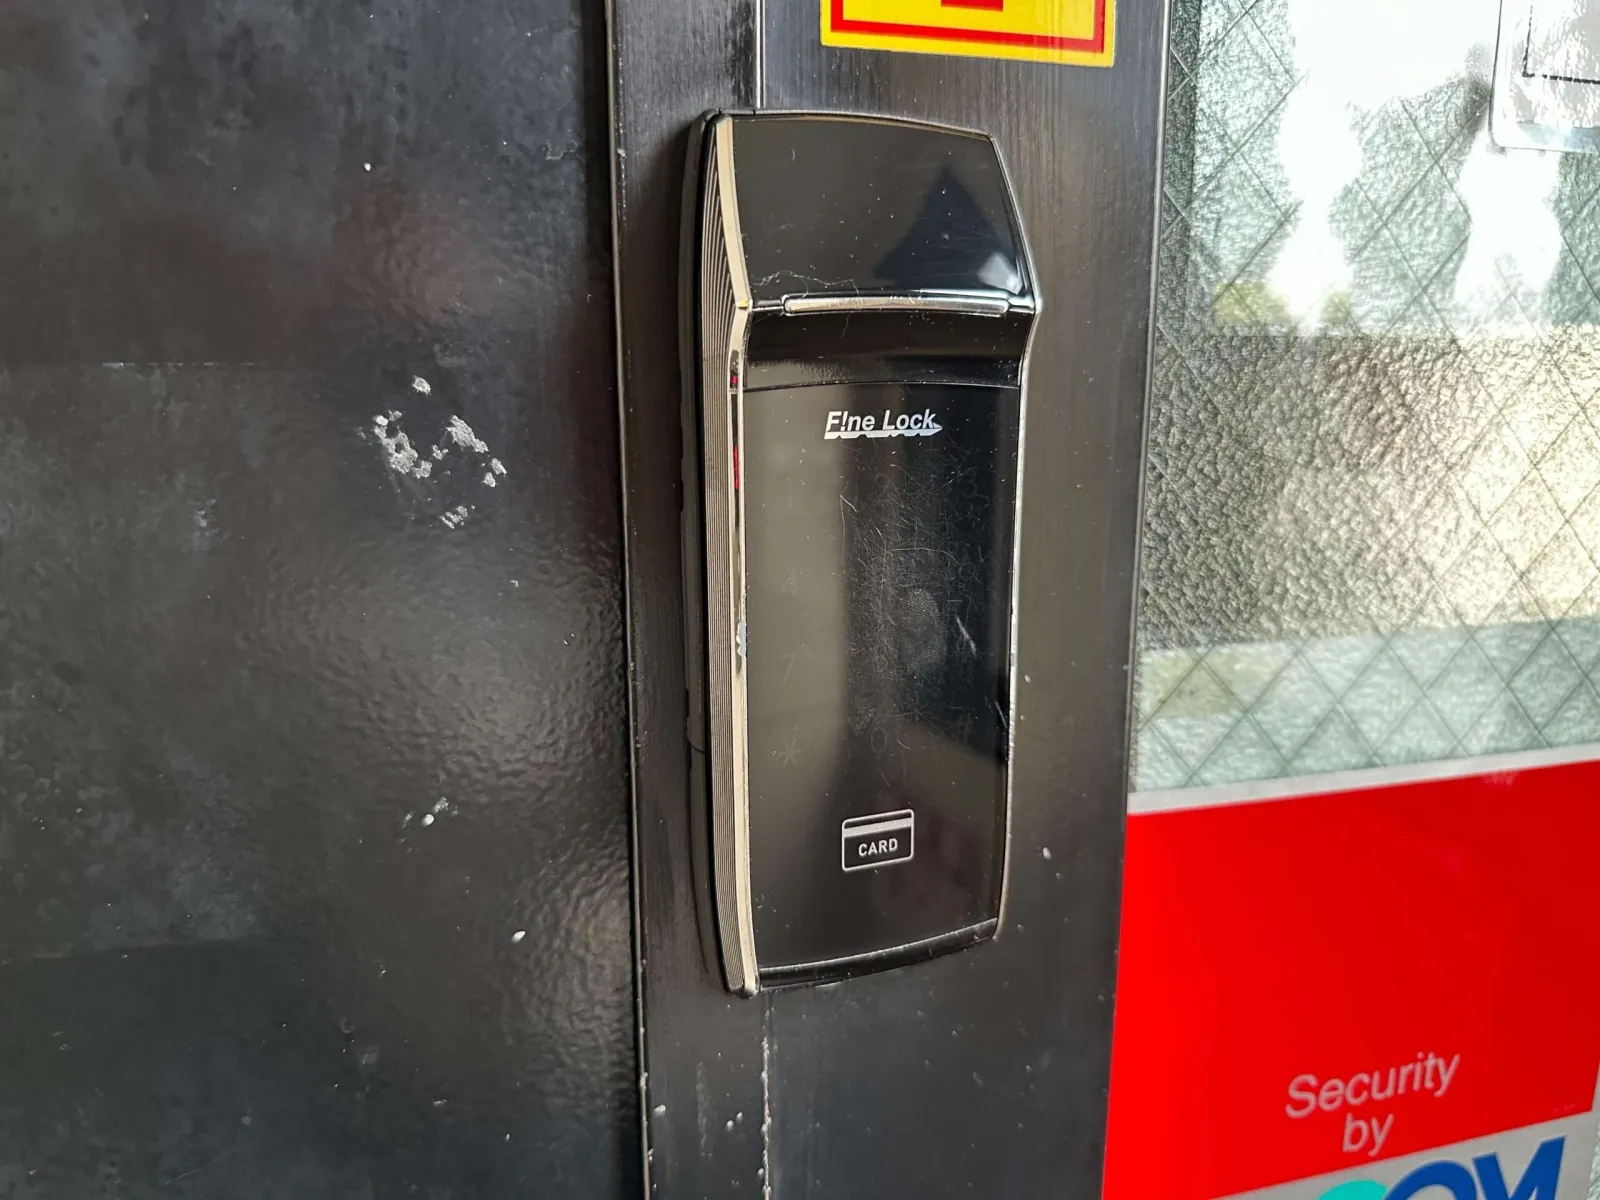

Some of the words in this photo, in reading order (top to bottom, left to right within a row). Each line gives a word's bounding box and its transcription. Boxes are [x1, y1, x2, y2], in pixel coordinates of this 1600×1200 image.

[882, 409, 937, 430] Lock
[858, 838, 898, 857] CARD
[1284, 1051, 1460, 1118] Security
[1342, 1112, 1394, 1157] by
